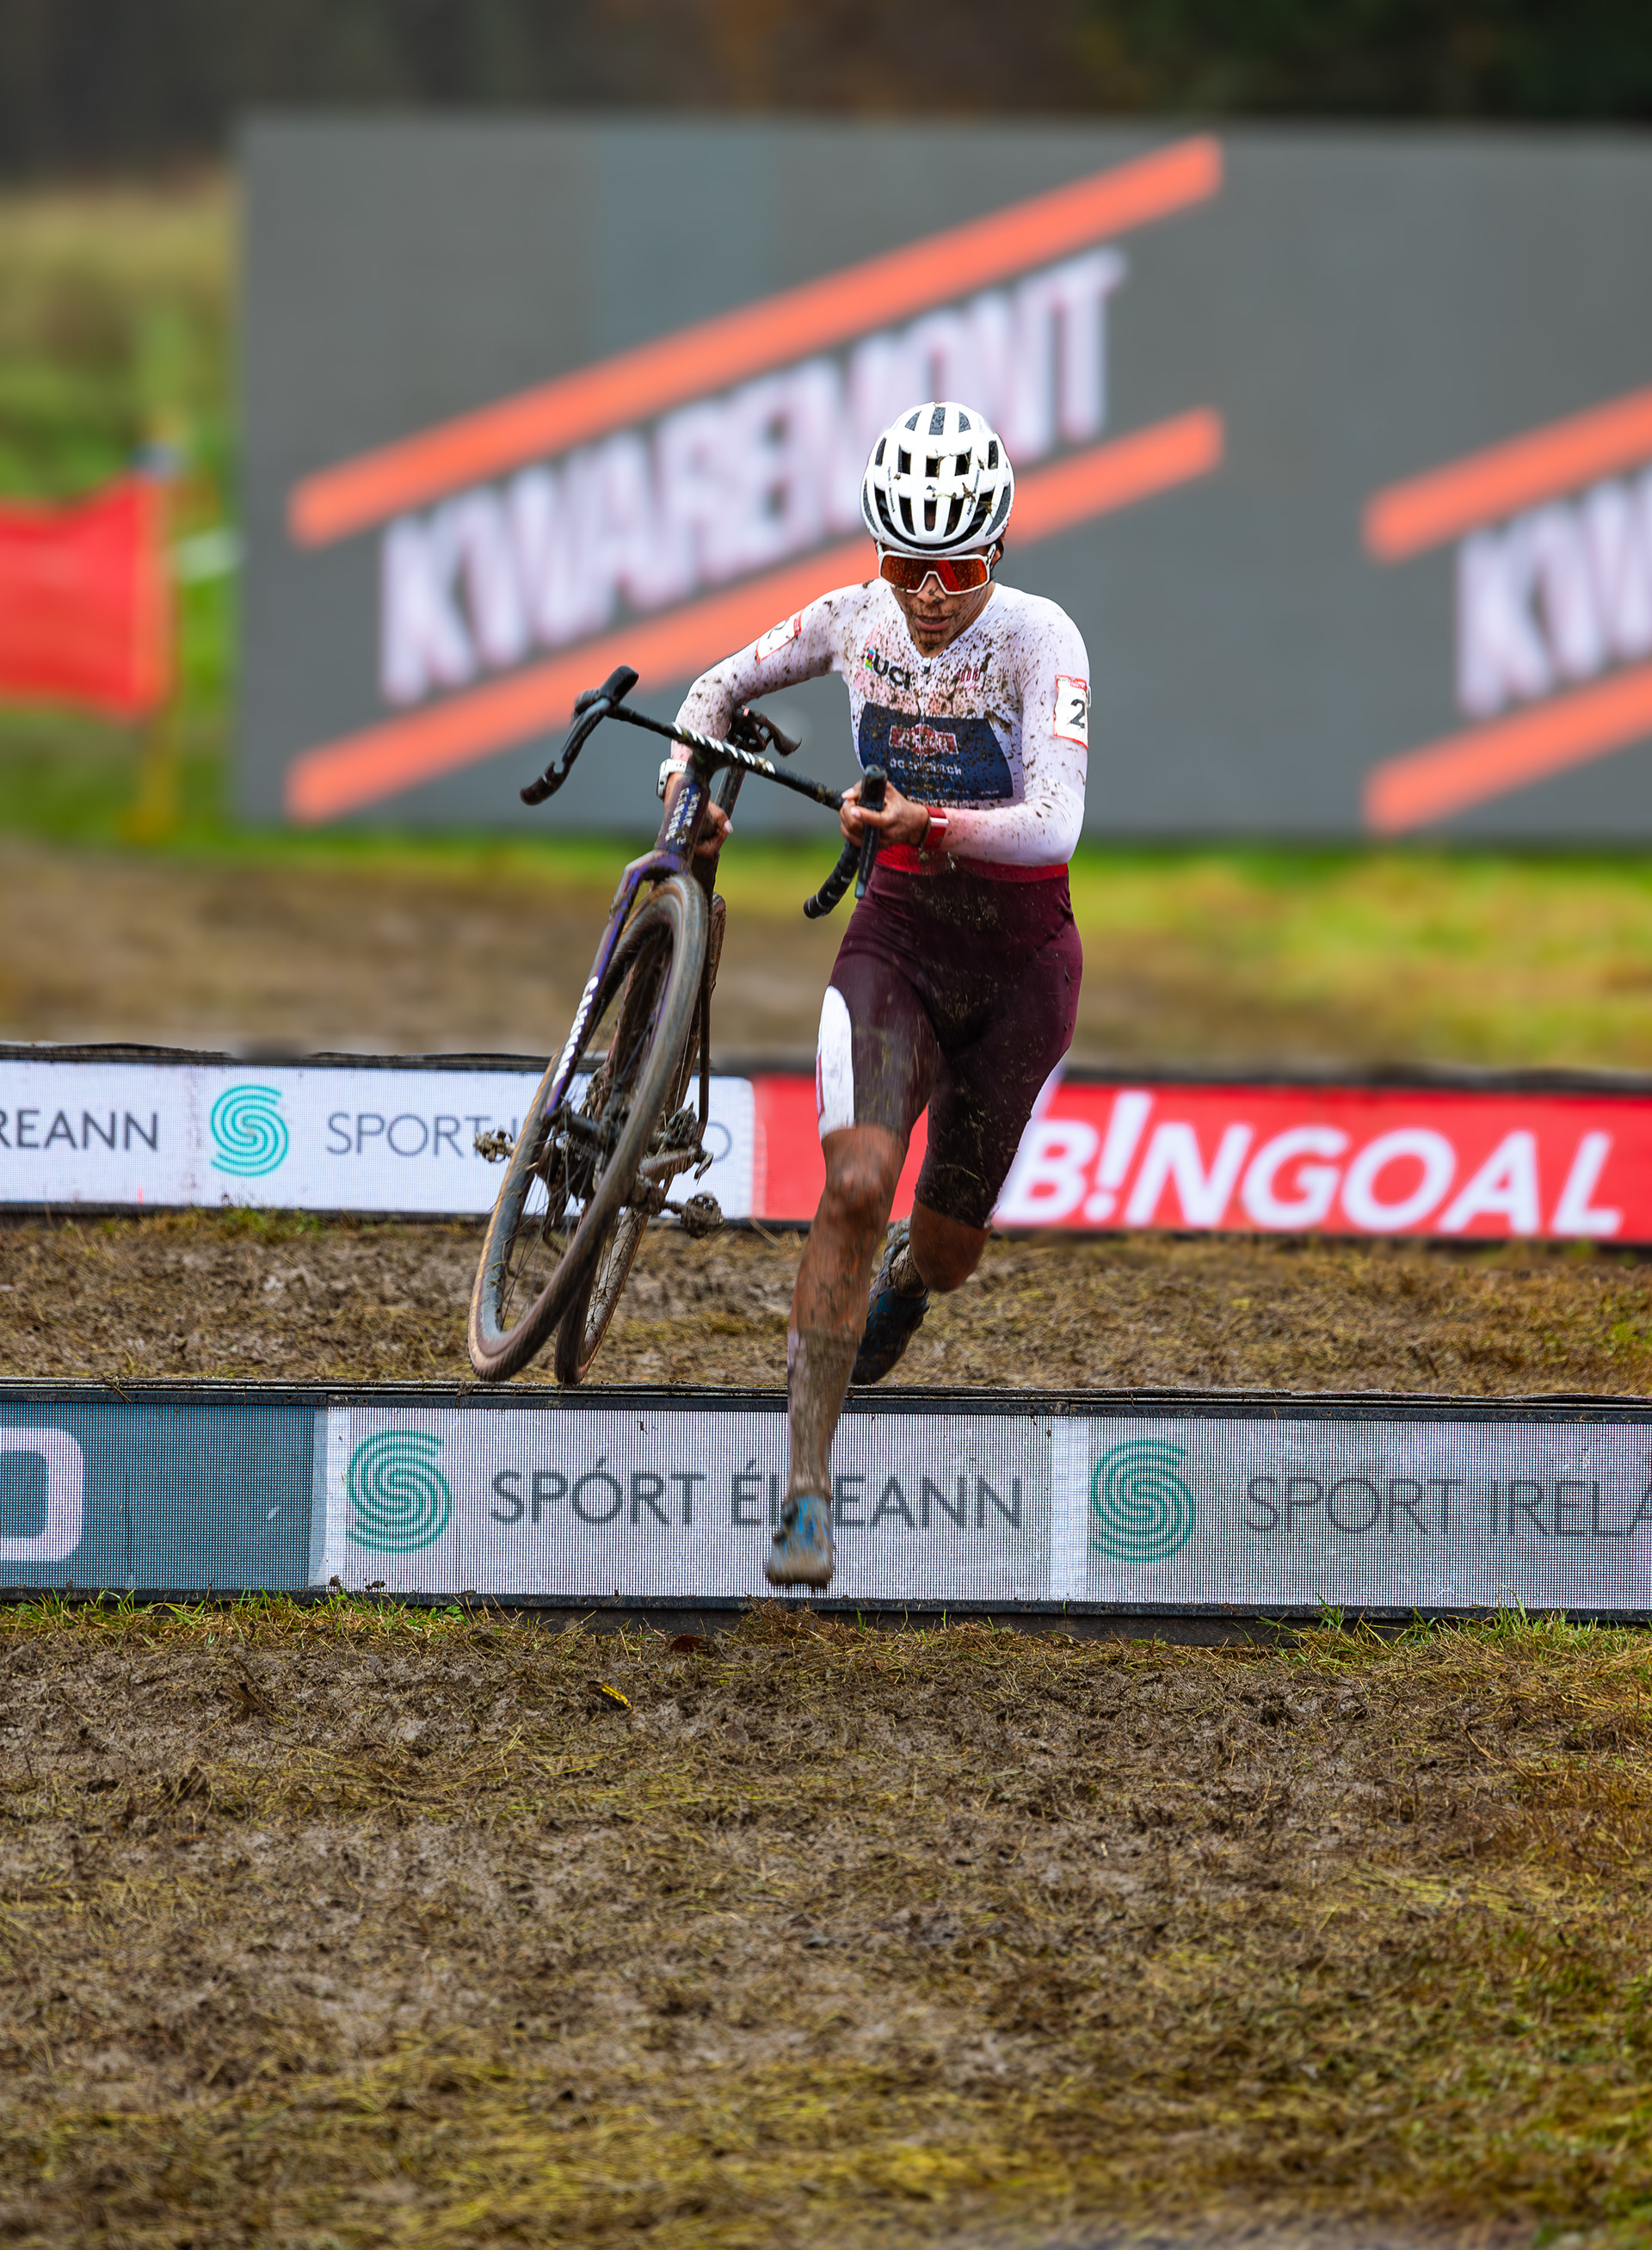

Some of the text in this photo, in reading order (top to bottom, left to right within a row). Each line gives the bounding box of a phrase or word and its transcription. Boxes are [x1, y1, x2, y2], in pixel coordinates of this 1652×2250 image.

[872, 653, 912, 691] UCI
[1070, 699, 1085, 729] 2
[491, 1456, 1022, 1529] SPÓRT ÉIEANN
[1247, 1476, 1463, 1535] SPORT
